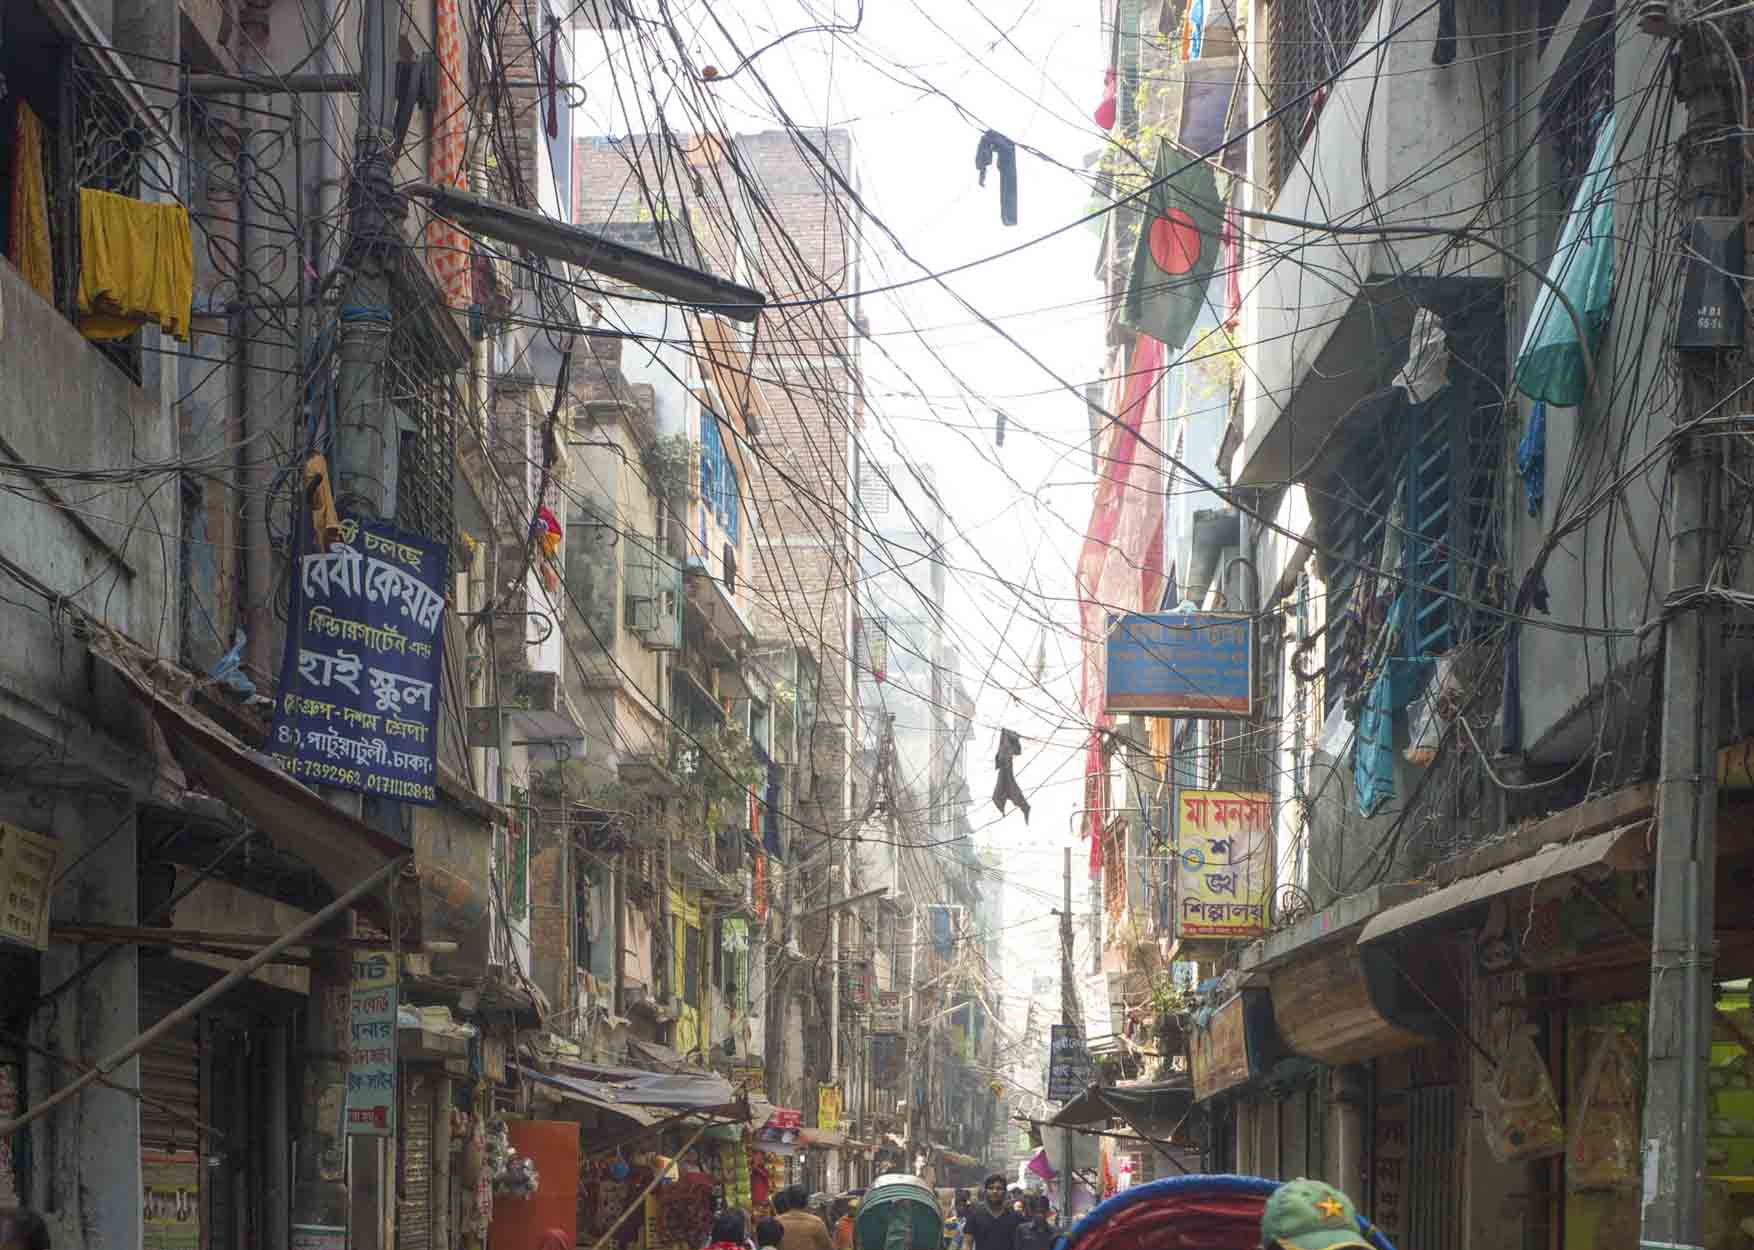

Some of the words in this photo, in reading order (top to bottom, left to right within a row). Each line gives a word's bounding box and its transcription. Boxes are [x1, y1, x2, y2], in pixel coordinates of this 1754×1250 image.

[301, 542, 363, 599] বেবী
[365, 555, 445, 634] কেয়ার
[298, 648, 362, 695] হাই
[368, 666, 433, 712] স্কুল
